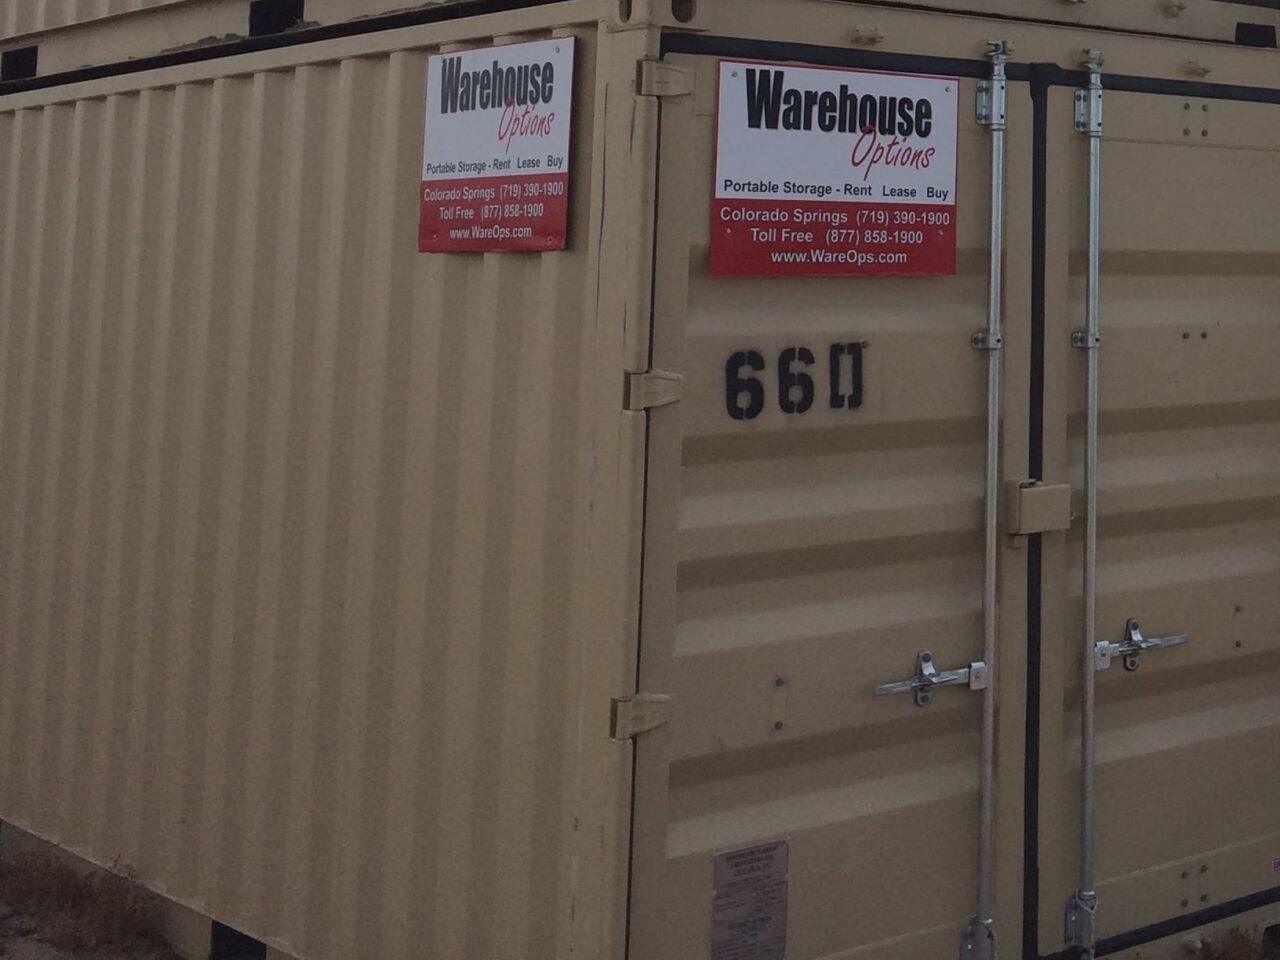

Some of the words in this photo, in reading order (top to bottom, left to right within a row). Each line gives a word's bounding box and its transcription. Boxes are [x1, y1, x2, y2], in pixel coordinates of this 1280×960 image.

[441, 56, 554, 114] Warehouse
[746, 68, 932, 138] Warehouse
[498, 104, 555, 154] Options
[852, 128, 935, 181] Options
[426, 162, 456, 175] Portable
[458, 161, 486, 174] Storage
[493, 158, 511, 170] Rent
[517, 157, 540, 169] Lease
[547, 155, 564, 169] Buy
[424, 188, 461, 202] Colorado
[462, 187, 495, 202] Springs
[499, 185, 521, 201] (719)
[524, 182, 564, 197] 390-1900
[724, 179, 779, 194] Portable
[784, 182, 832, 197] Storage
[844, 184, 872, 197] Rent
[882, 185, 917, 198] Lease
[927, 187, 949, 201] Buy
[439, 207, 454, 220] Toll
[456, 206, 474, 219] Free
[481, 205, 502, 221] (877)
[504, 204, 544, 218] 858-1900
[720, 207, 789, 222] Colorado
[793, 208, 848, 225] Springs
[856, 210, 889, 227] (719)
[893, 211, 950, 226] 390-1900
[450, 225, 532, 242] www.WareOps.com
[750, 228, 776, 242] Toll
[781, 228, 814, 243] Free
[826, 229, 859, 246] (877)
[864, 230, 923, 244] 858-1900
[771, 249, 907, 266] www.WareOps.com
[725, 342, 863, 420] 660
